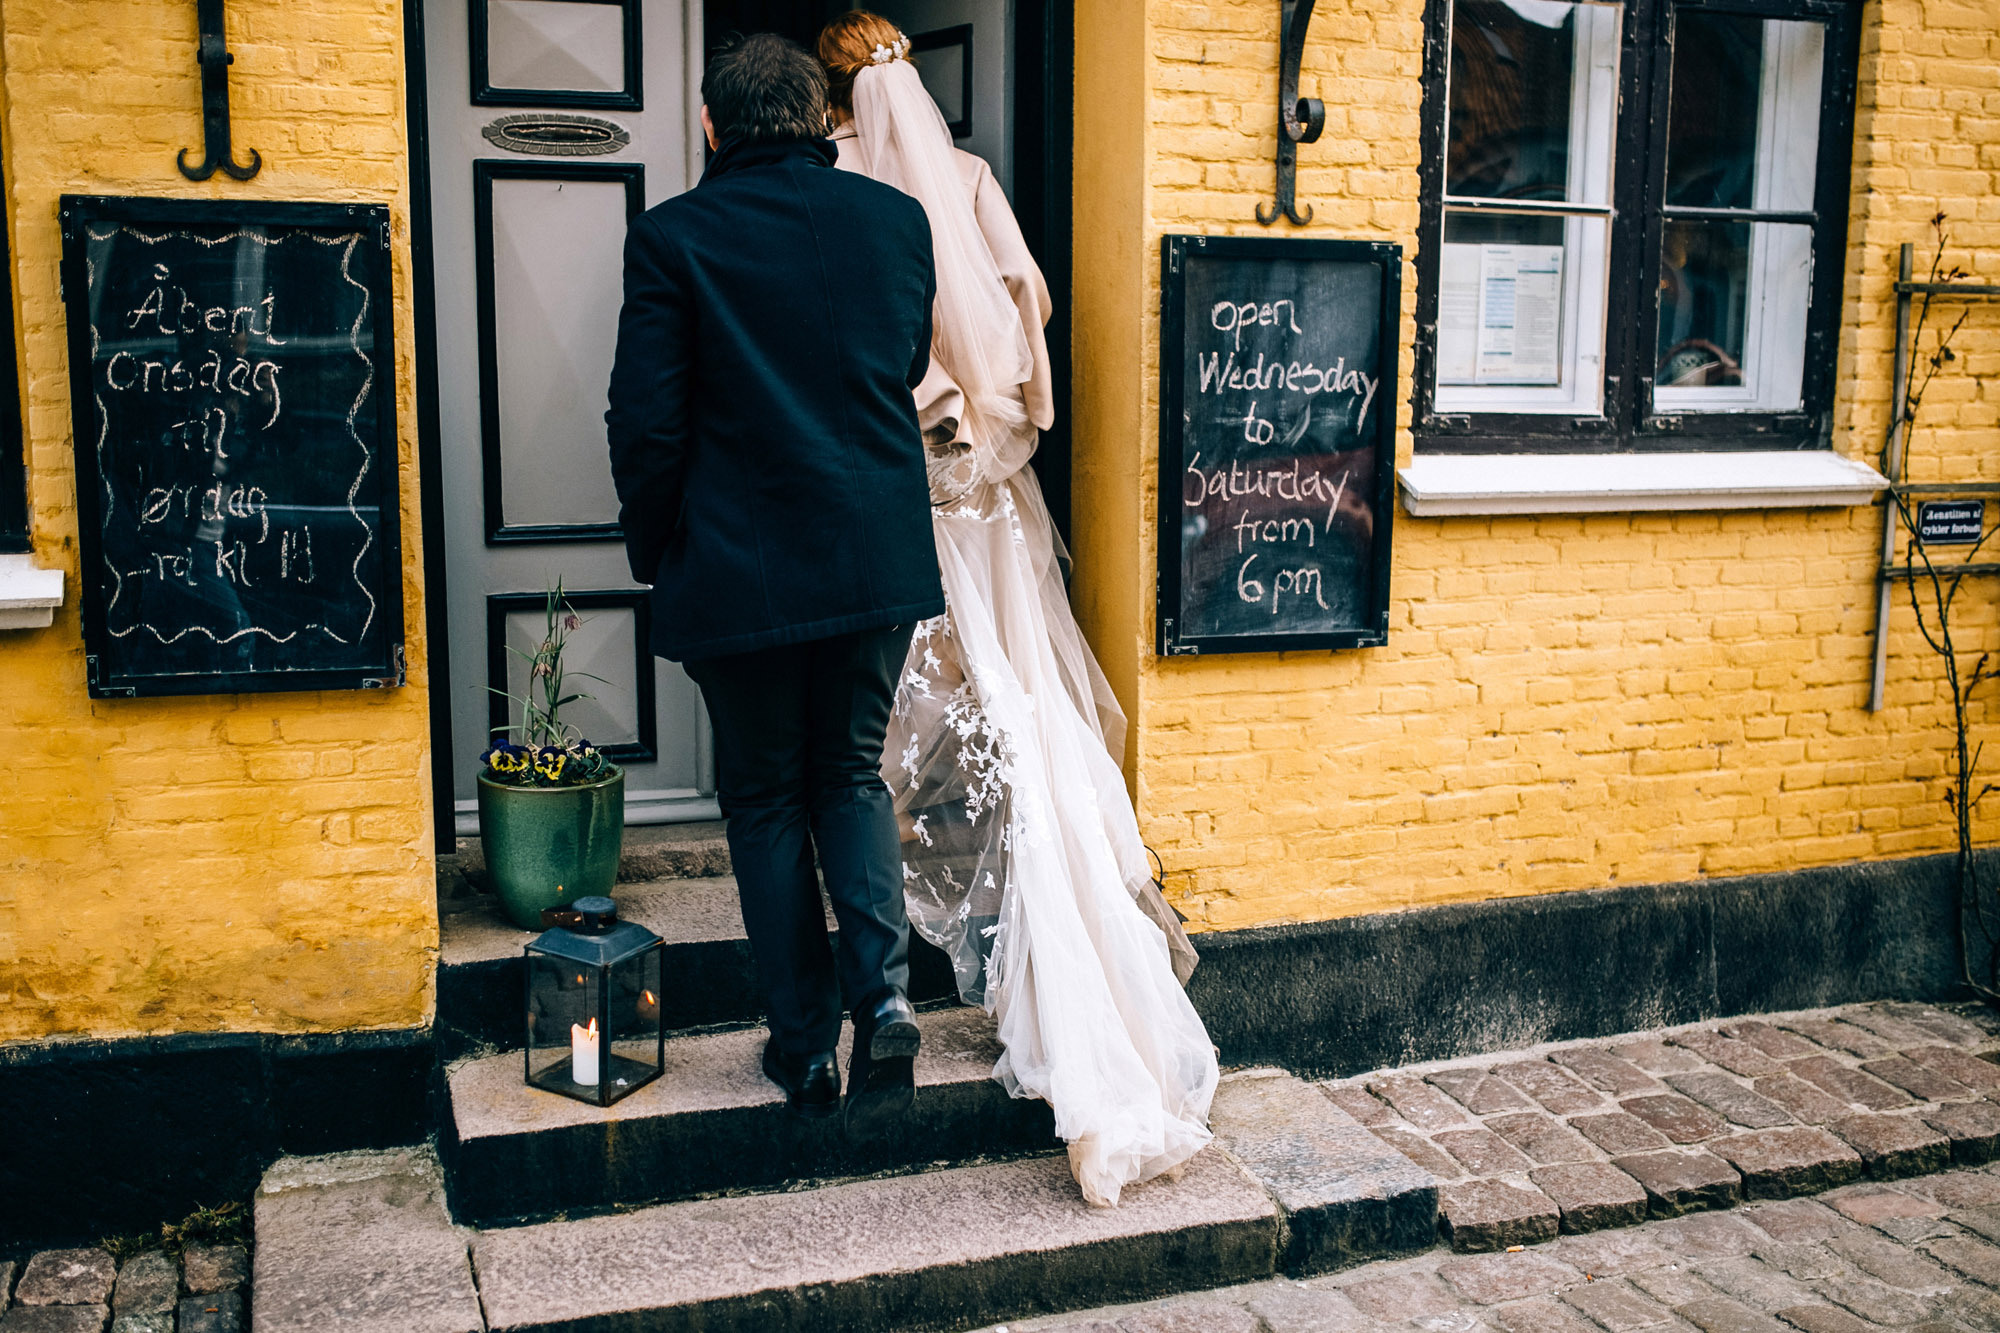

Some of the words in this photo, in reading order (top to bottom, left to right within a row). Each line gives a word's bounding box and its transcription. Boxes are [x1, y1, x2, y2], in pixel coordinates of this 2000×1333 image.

[126, 262, 286, 346] Åbent
[1199, 351, 1379, 435] Wednesday
[1243, 401, 1275, 445] to
[1184, 451, 1350, 534] Saturday
[1232, 508, 1315, 554] from
[1237, 554, 1266, 603] 6
[1272, 568, 1330, 615] pm
